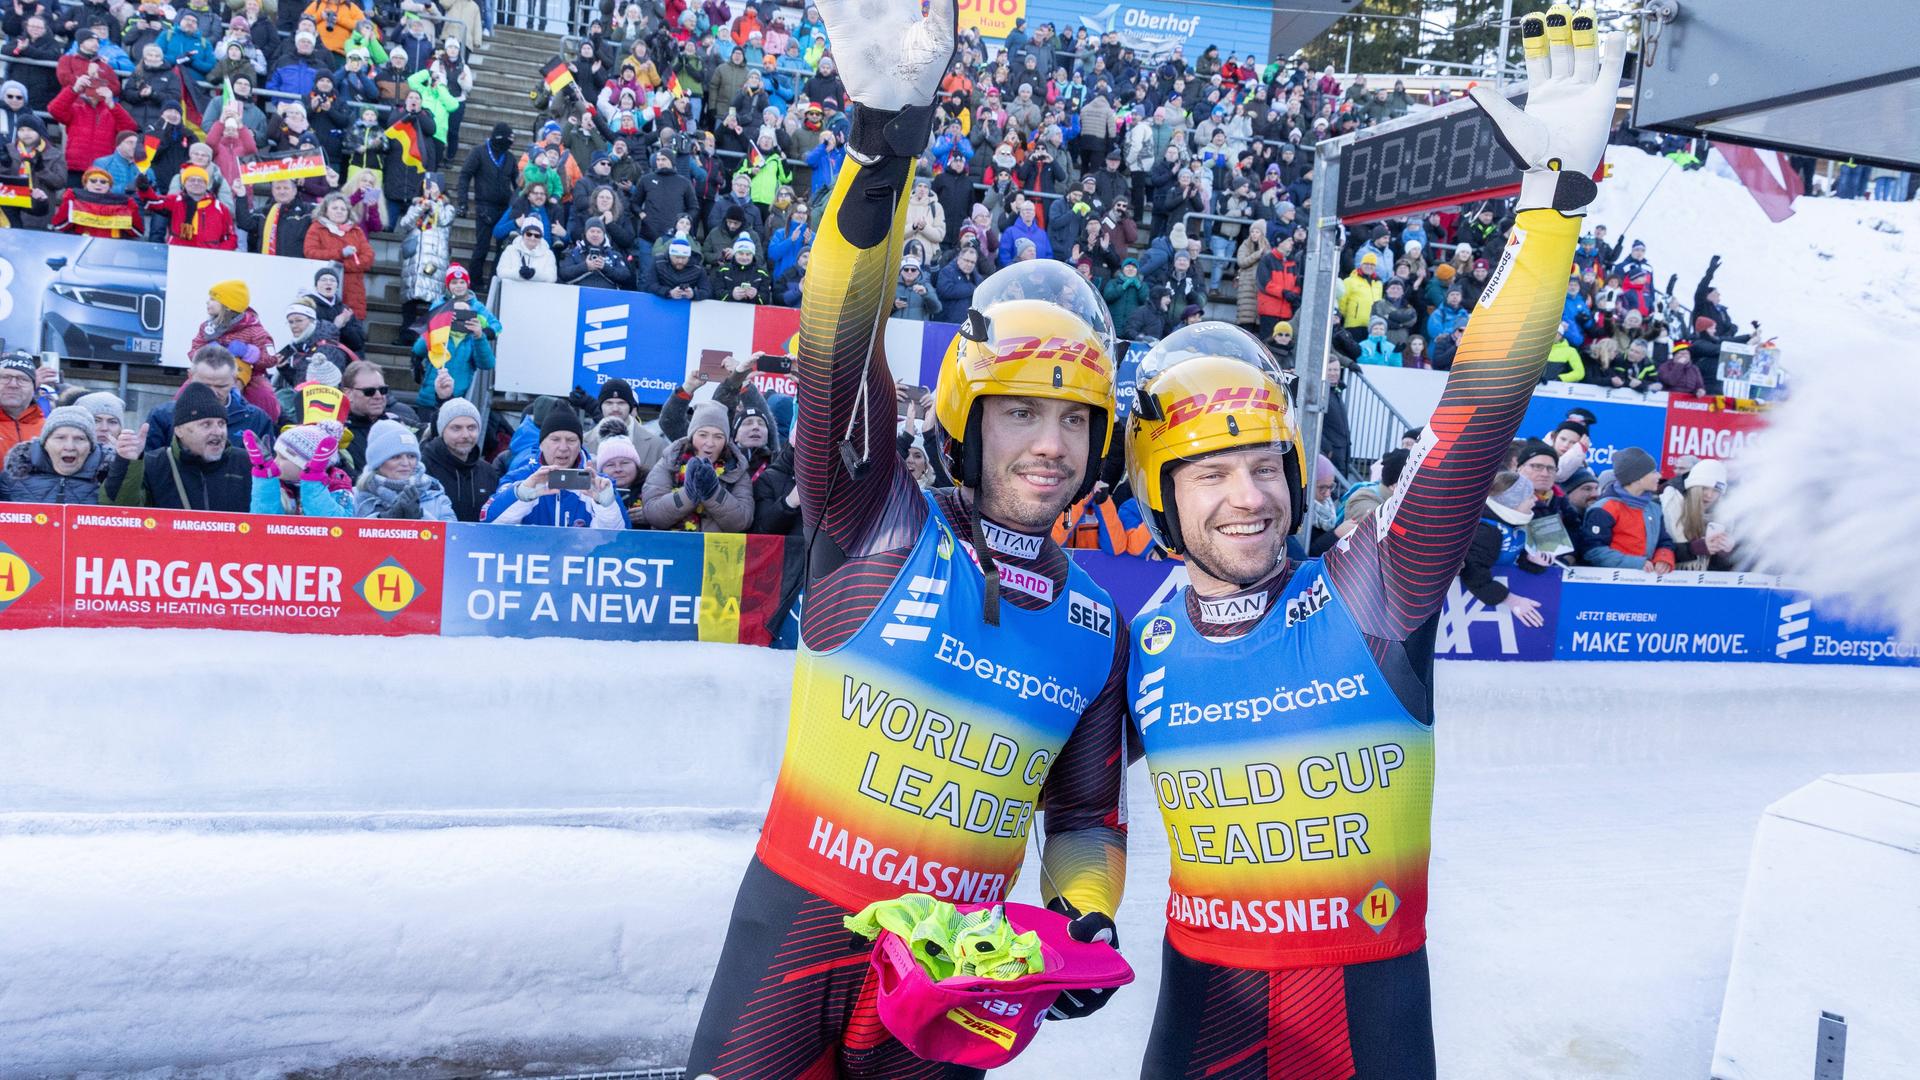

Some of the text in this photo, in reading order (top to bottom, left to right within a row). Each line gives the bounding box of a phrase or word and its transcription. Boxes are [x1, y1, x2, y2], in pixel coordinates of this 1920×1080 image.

[980, 16, 1006, 28] Haus
[1124, 8, 1200, 37] Oberhof
[1481, 251, 1512, 303] Sporthilfe
[995, 336, 1105, 375] DHL
[754, 375, 797, 396] HARG
[1167, 387, 1282, 428] DHL
[77, 515, 141, 528] HARGASSNER
[173, 519, 236, 533] HARGASSNER
[267, 524, 328, 537] HARGASSNER
[359, 528, 418, 540] HARGASSNER
[983, 523, 1040, 553] TITAN
[75, 557, 342, 603] HARGASSNER
[468, 552, 550, 585] THE
[562, 556, 674, 589] FIRST
[75, 599, 341, 618] BIOMASS HEATING TECHNOLOGY
[466, 588, 522, 620] OF
[530, 592, 560, 622] A
[570, 593, 660, 624] NEW
[1576, 611, 1657, 623] JETZT BEWERBEN!
[1572, 631, 1748, 655] MAKE YOUR MOVE.
[934, 633, 1088, 715] Eberspäche
[1168, 673, 1369, 727] Eberspächer
[841, 674, 1019, 777] WORLD
[1298, 743, 1405, 799] CUP
[858, 752, 1033, 838] LEADER
[1172, 812, 1371, 864] LEADER
[808, 816, 1005, 904] HARGASSNER
[1169, 892, 1349, 934] HARGASSNER
